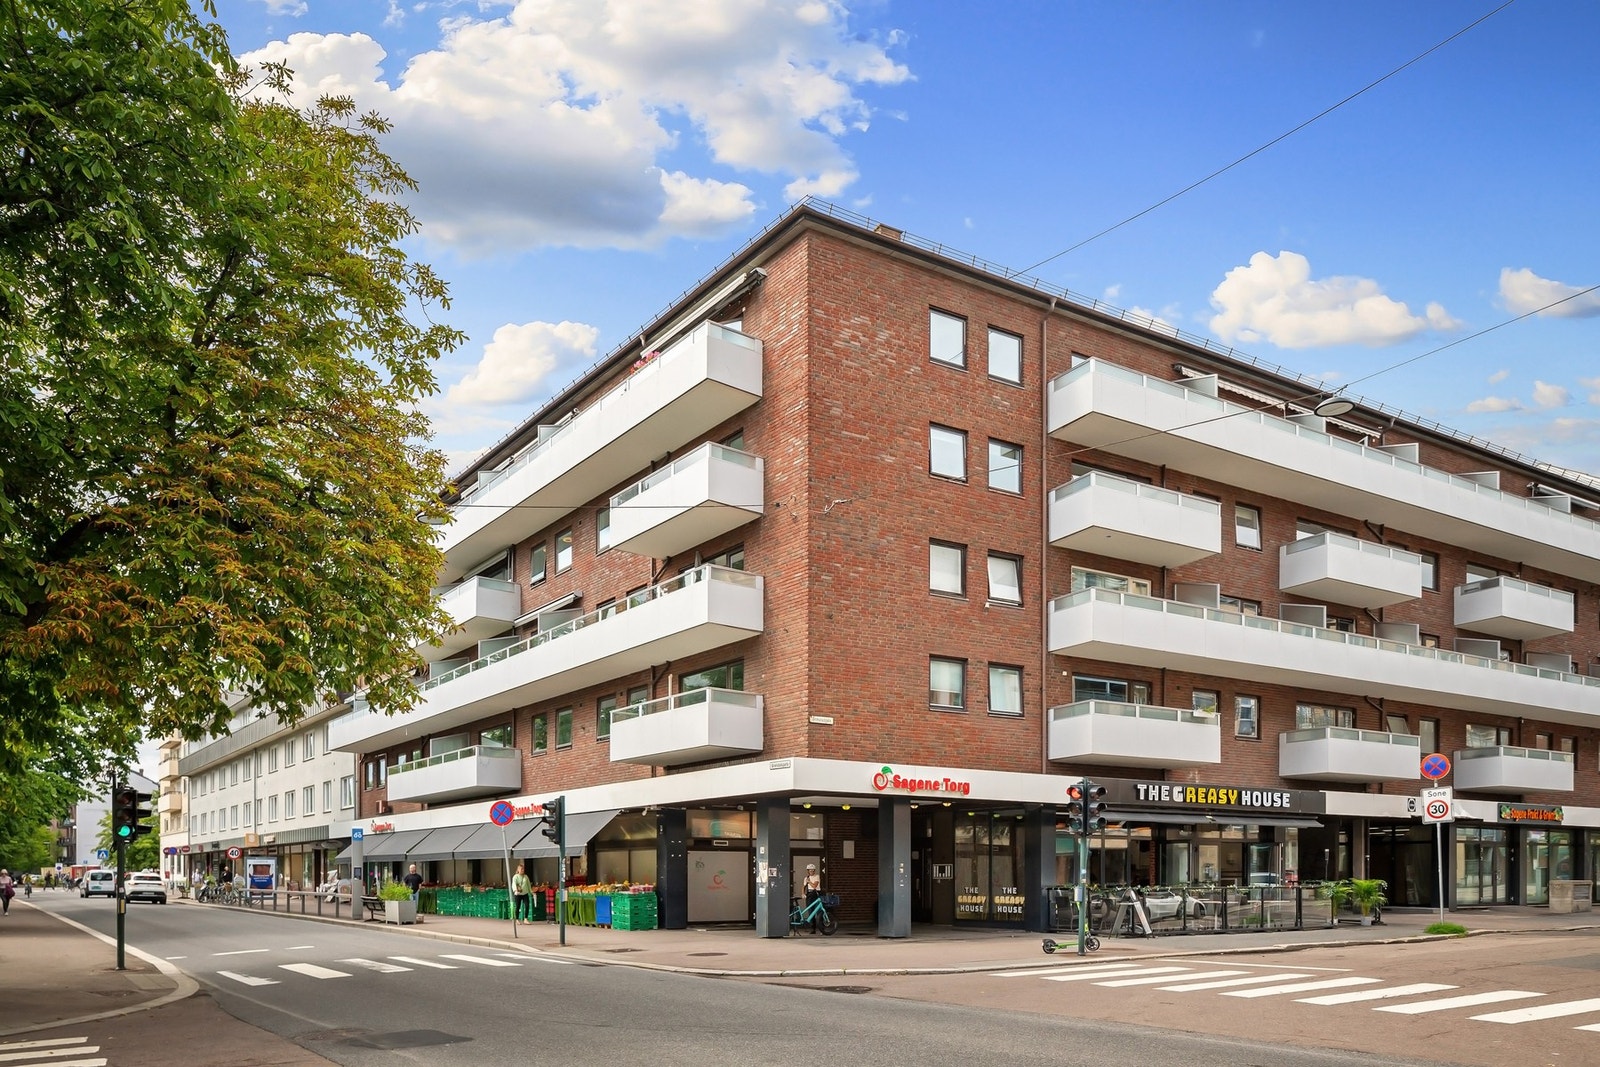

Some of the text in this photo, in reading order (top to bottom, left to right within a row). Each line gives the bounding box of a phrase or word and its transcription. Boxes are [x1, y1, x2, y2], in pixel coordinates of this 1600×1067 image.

[892, 774, 971, 796] Sagene Torg
[1137, 784, 1291, 808] THE GREASY HOUSE
[1427, 790, 1447, 798] Sone
[1430, 804, 1445, 814] 30
[229, 849, 239, 857] 40
[1002, 887, 1017, 895] THE
[957, 895, 987, 904] GREASY
[994, 896, 1025, 905] GREASY
[960, 905, 984, 913] HOUSE
[997, 906, 1022, 914] HOUSE
